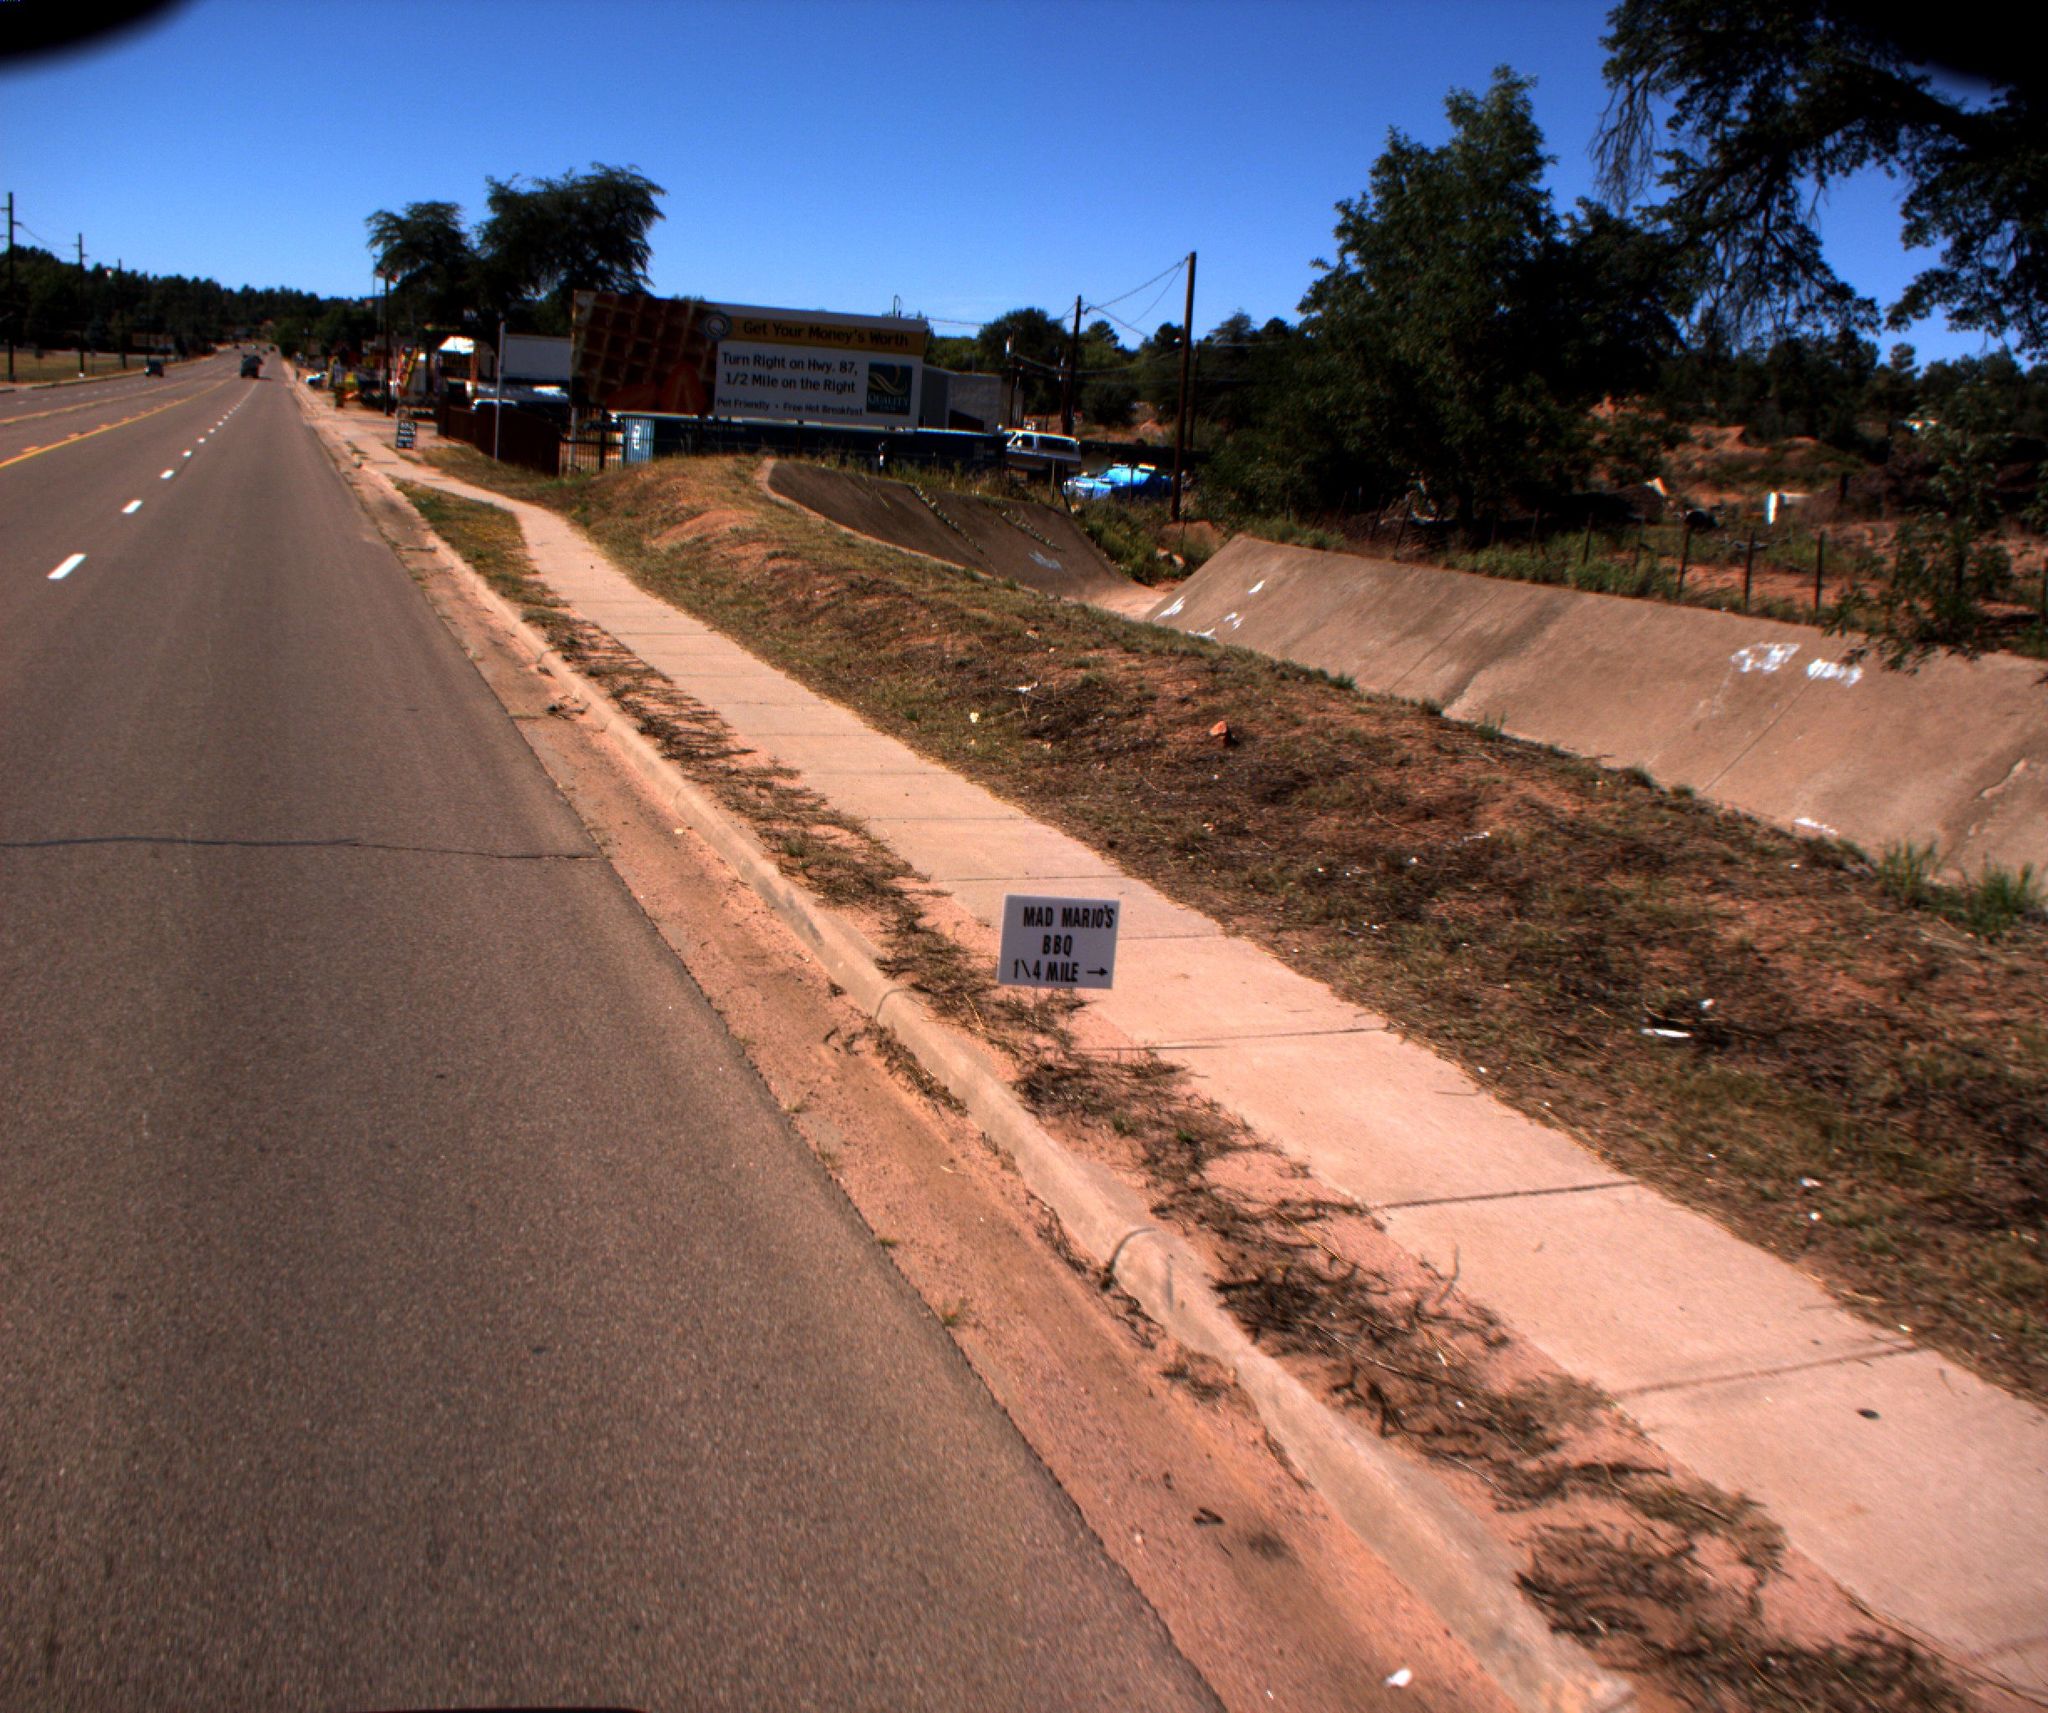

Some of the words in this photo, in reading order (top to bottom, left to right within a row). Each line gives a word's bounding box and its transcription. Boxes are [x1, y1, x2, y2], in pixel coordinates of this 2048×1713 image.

[743, 319, 767, 335] Get
[773, 321, 805, 337] Your
[809, 325, 865, 344] Money's
[870, 330, 908, 347] Worth
[722, 351, 750, 365] Turn
[753, 353, 786, 370] Right
[790, 358, 805, 370] on
[808, 357, 835, 374] Hwy.
[839, 359, 858, 376] 87,
[726, 371, 748, 386] 1/2
[752, 373, 779, 388] Mile
[781, 378, 797, 389] on
[800, 376, 821, 391] the
[823, 379, 856, 394] Right
[734, 398, 770, 411] Friendly
[822, 404, 863, 416] Breakfast
[1023, 906, 1053, 928] MAD
[1061, 905, 1115, 929] MARIO'S
[1042, 934, 1073, 957] BBQ
[1045, 961, 1079, 983] MILE
